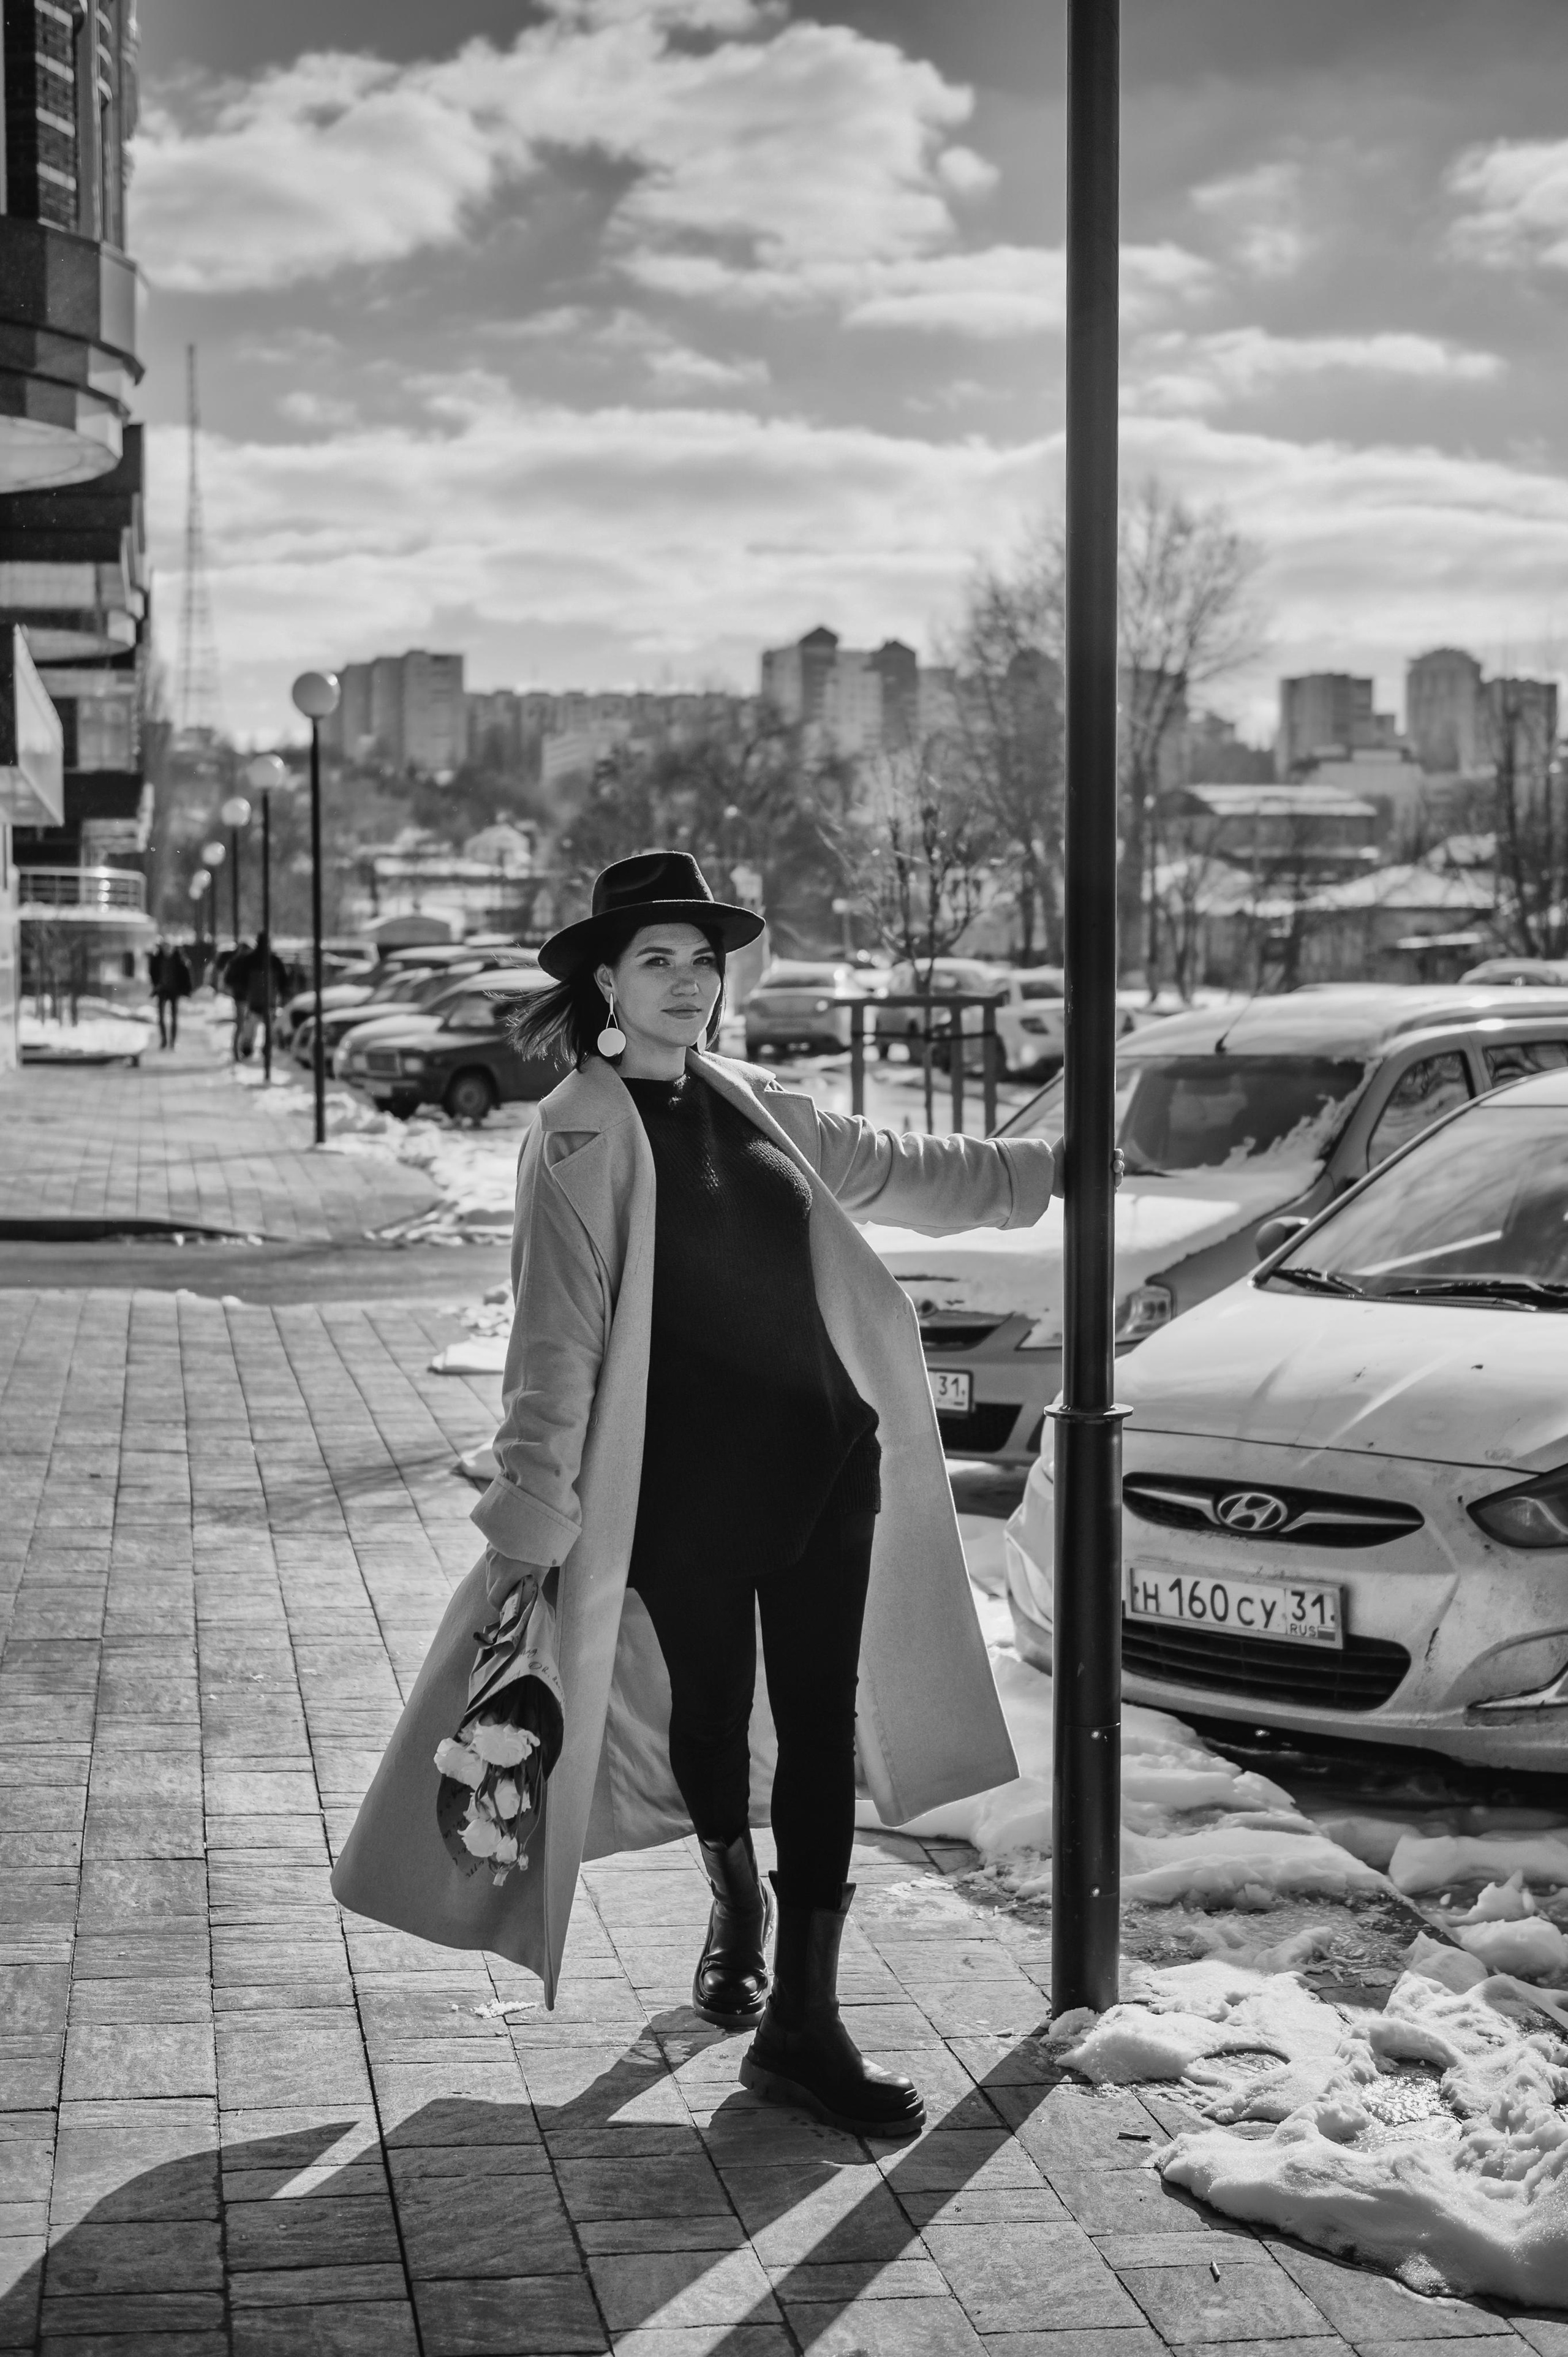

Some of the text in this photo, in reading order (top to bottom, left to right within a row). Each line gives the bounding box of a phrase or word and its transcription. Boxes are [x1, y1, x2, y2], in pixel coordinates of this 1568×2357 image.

[939, 1375, 959, 1397] 31
[1291, 1591, 1325, 1625] 31
[1290, 1623, 1317, 1637] RUS
